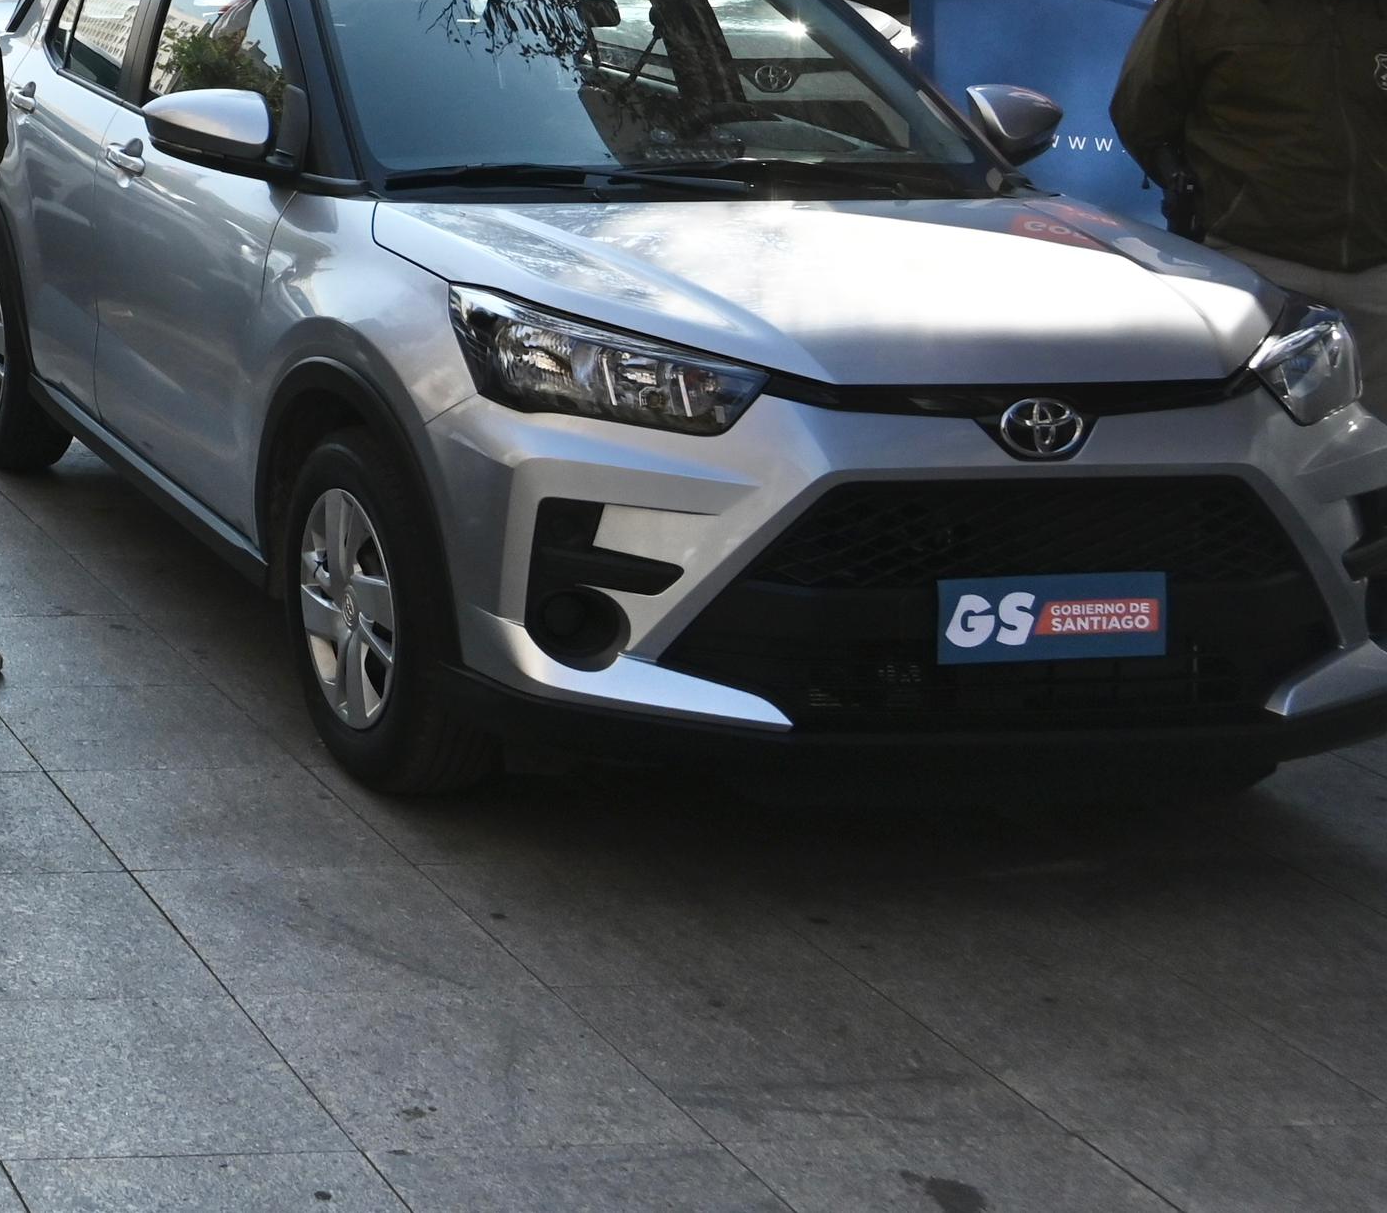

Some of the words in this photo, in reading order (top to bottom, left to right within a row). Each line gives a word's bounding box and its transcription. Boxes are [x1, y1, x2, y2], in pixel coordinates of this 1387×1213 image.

[1050, 603, 1126, 617] GOBIERNO
[1129, 602, 1150, 613] DE
[945, 591, 1036, 648] GS
[1051, 615, 1150, 632] SANTIAGO
